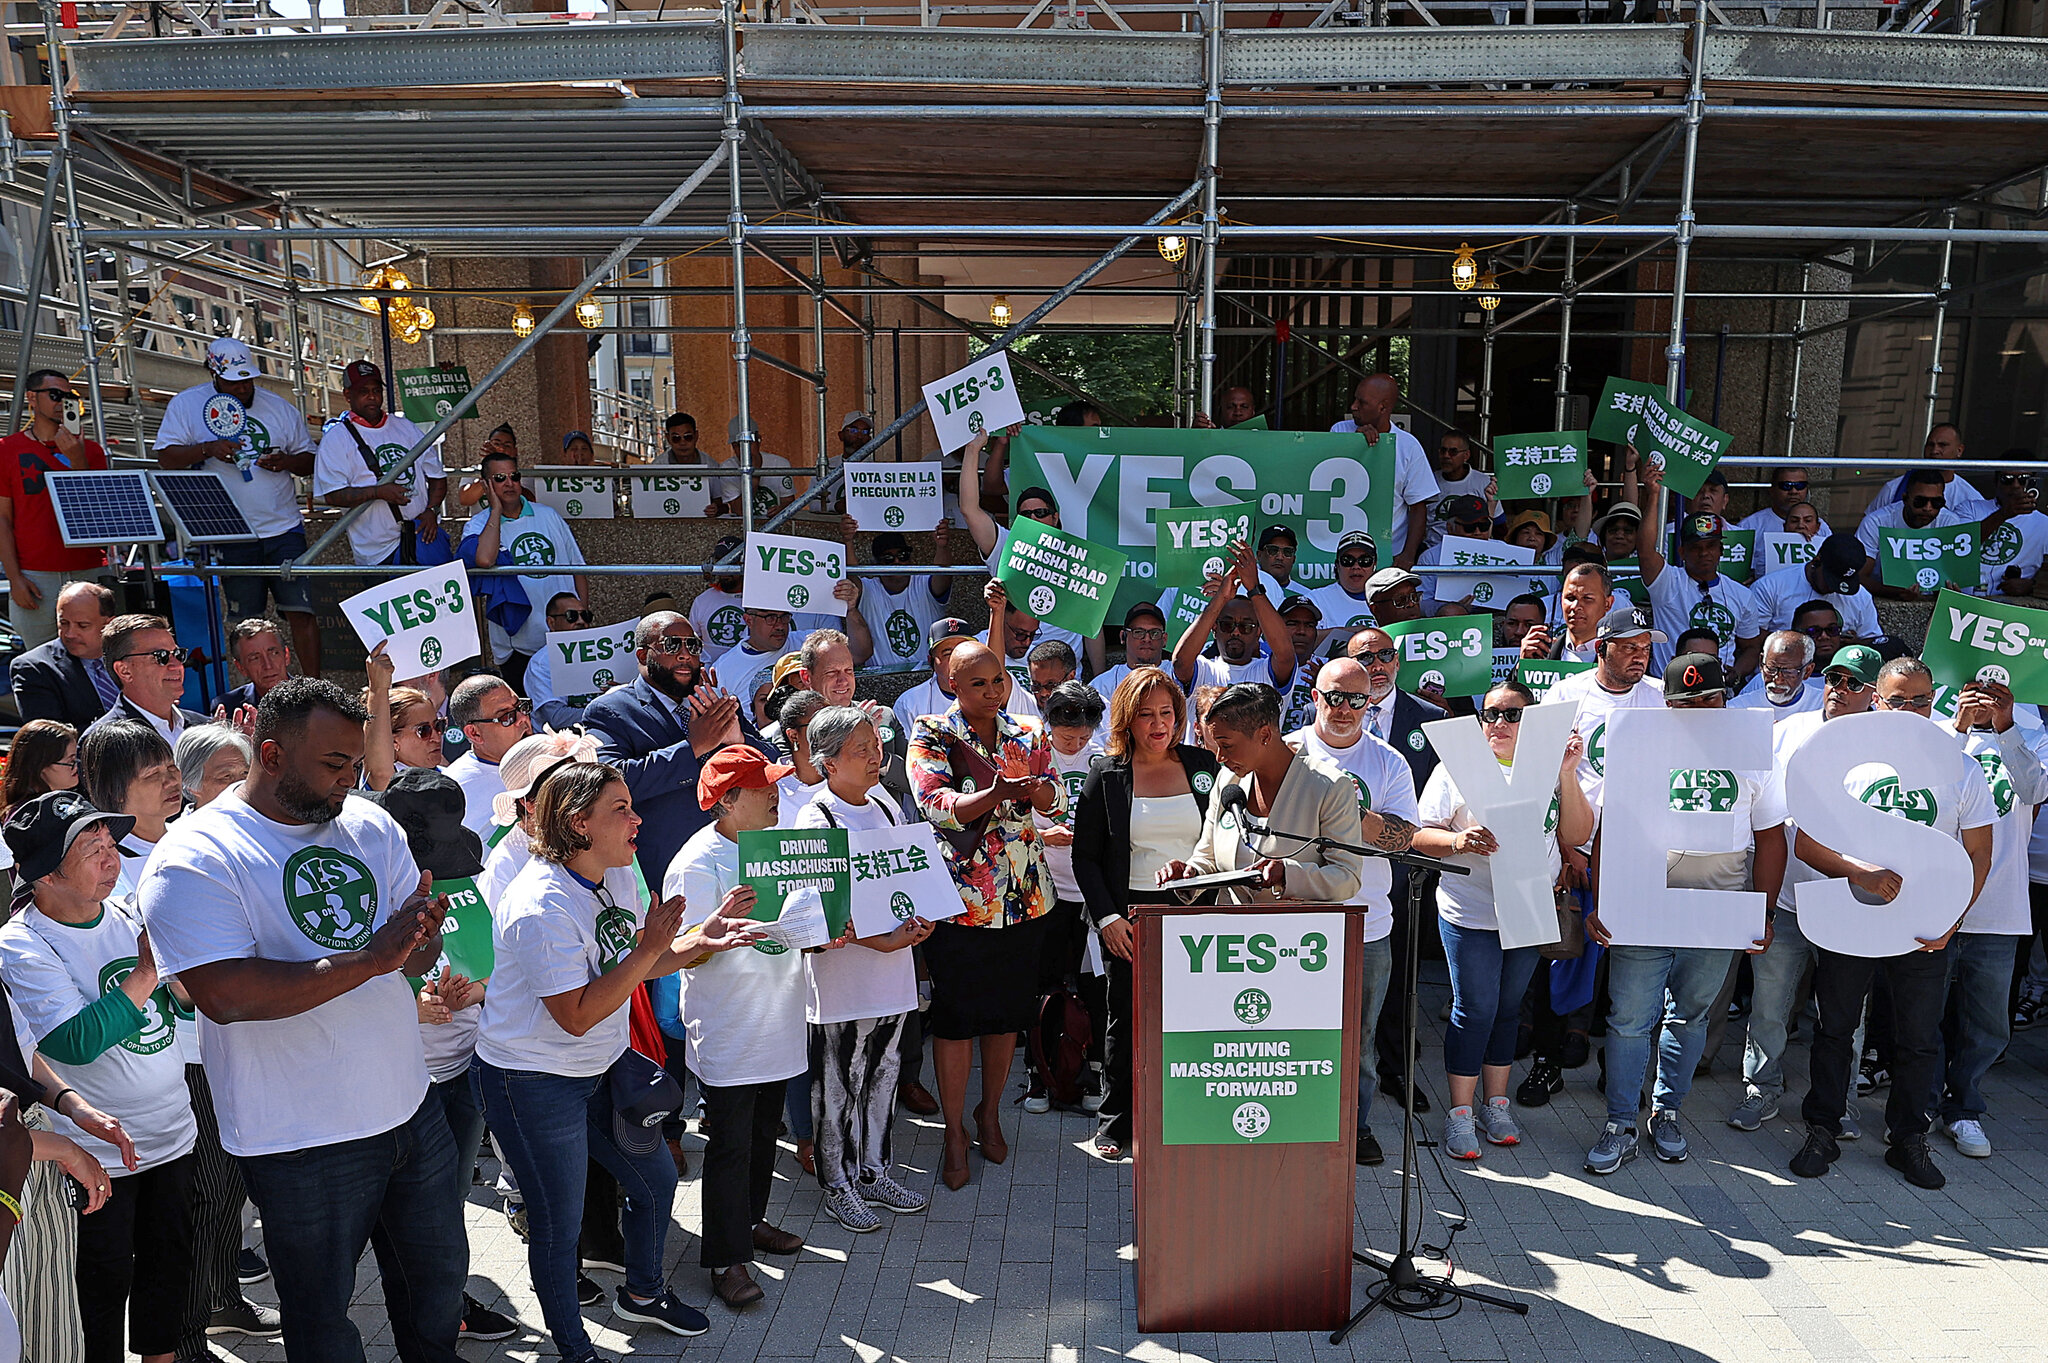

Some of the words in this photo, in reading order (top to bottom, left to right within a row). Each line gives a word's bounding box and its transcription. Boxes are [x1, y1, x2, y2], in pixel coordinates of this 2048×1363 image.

[402, 375, 430, 386] VOTA
[431, 374, 441, 383] SI
[442, 373, 454, 383] EN
[454, 373, 466, 382] LA
[404, 385, 457, 397] PREGUNTA
[457, 384, 469, 393] #3
[935, 376, 980, 416] YES
[979, 379, 989, 388] ON
[987, 366, 1005, 391] 3
[1610, 392, 1646, 415] 支持
[1646, 395, 1668, 424] VOTA
[1667, 418, 1681, 434] SI
[1682, 424, 1702, 444] EN
[1700, 433, 1721, 453] LA
[1642, 408, 1691, 457] PREGUNTA
[1690, 448, 1713, 467] #3
[1504, 444, 1577, 466] 支持工会
[542, 477, 582, 492] YES
[593, 477, 605, 493] 3
[640, 477, 680, 492] YES
[690, 477, 702, 492] 3
[850, 472, 882, 484] VOTA
[884, 472, 897, 483] SI
[899, 472, 917, 483] EN
[918, 472, 936, 483] LA
[851, 486, 916, 498] PREGUNTA
[918, 486, 937, 497] #3
[1035, 452, 1257, 546] YES
[1262, 493, 1303, 517] ON
[1305, 457, 1371, 553] 3
[1166, 518, 1228, 549] YES
[1236, 515, 1249, 542] 3
[518, 537, 544, 553] YES
[1037, 532, 1088, 562] FADLAN
[1720, 543, 1746, 562] 工会
[1773, 543, 1817, 564] YES
[1887, 536, 1942, 561] YES
[1954, 533, 1972, 557] 3
[531, 551, 542, 565] 3
[757, 545, 815, 576] YES
[826, 553, 841, 579] 3
[1012, 540, 1069, 573] SU'AASHA
[1069, 561, 1108, 586] 3AAD
[1008, 555, 1027, 572] KU
[1025, 563, 1067, 589] CODEE
[1067, 578, 1100, 601] HAA.
[361, 588, 437, 637] YES
[434, 596, 447, 606] ON
[444, 579, 464, 614] 3
[1182, 593, 1209, 611] VOT
[317, 615, 346, 629] EDW
[718, 611, 742, 624] YES
[892, 616, 908, 630] YES
[1631, 610, 1647, 625] NY
[722, 624, 734, 640] 3
[1949, 606, 2031, 656] YES
[2028, 637, 2046, 648] ON
[557, 637, 614, 664] YES
[623, 630, 635, 653] 3
[1448, 639, 1461, 648] ON
[1461, 628, 1483, 657] 3
[429, 651, 435, 660] 3
[1987, 669, 2004, 679] YES
[1290, 709, 1303, 729] 3
[1681, 769, 1721, 788] YES
[1692, 788, 1712, 811] 3
[1878, 785, 1920, 808] YES
[1421, 700, 1974, 958] YES
[779, 838, 828, 856] DRIVING
[745, 856, 848, 878] MASSACHUSETTS
[851, 844, 931, 882] 支持工会
[296, 859, 348, 892] YES
[321, 907, 334, 917] ON
[325, 893, 352, 930] 3
[899, 904, 908, 916] 3
[300, 920, 316, 937] THE
[315, 933, 347, 948] OPTION
[354, 929, 371, 947] JOIN
[1179, 933, 1277, 973] YES
[1279, 947, 1298, 958] ON
[1299, 932, 1328, 972] 3
[1243, 993, 1263, 1004] YES
[1247, 1004, 1258, 1017] 3
[127, 1041, 150, 1053] OPTION
[150, 1042, 161, 1051] TO
[1213, 1041, 1291, 1058] DRIVING
[1170, 1059, 1333, 1078] MASSACHUSETTS
[1205, 1081, 1297, 1097] FORWARD
[1242, 1106, 1262, 1117] YES
[1246, 1118, 1257, 1130] 3
